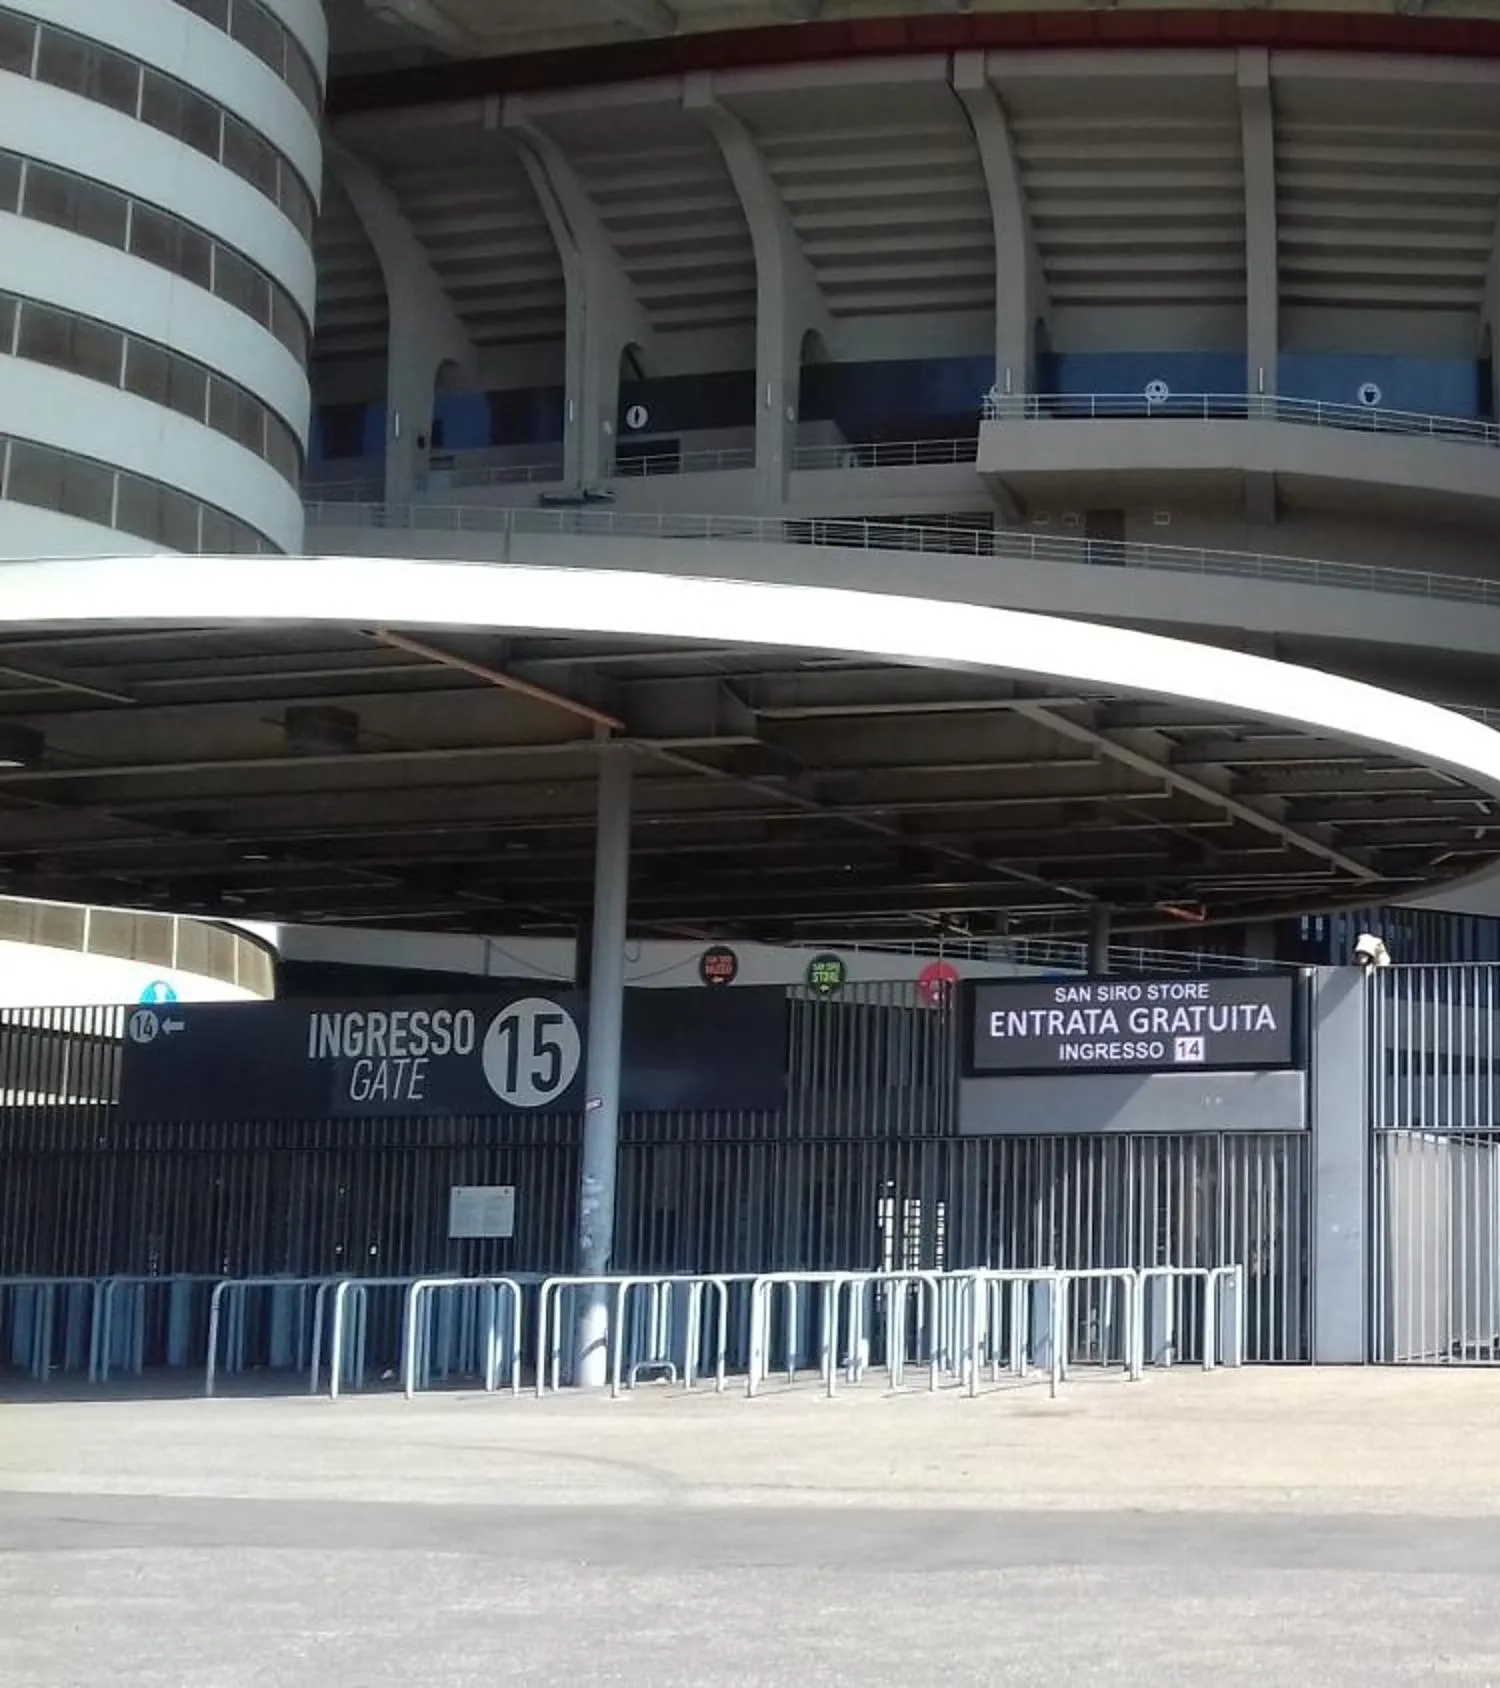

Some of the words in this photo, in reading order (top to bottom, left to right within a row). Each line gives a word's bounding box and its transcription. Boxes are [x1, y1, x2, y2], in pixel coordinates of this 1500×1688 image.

[811, 972, 840, 983] STORE
[1054, 986, 1091, 1003] SAN
[1097, 985, 1142, 1002] SIRO
[1147, 983, 1209, 1001] STORE
[137, 1013, 153, 1039] 14
[308, 1009, 475, 1059] INGRESSO
[990, 1008, 1119, 1037] ENTRATA
[1128, 1004, 1277, 1034] GRATUITA
[497, 1013, 564, 1092] 15
[1059, 1041, 1165, 1061] INGRESSO
[1177, 1037, 1202, 1059] 14
[349, 1058, 431, 1101] GATE
